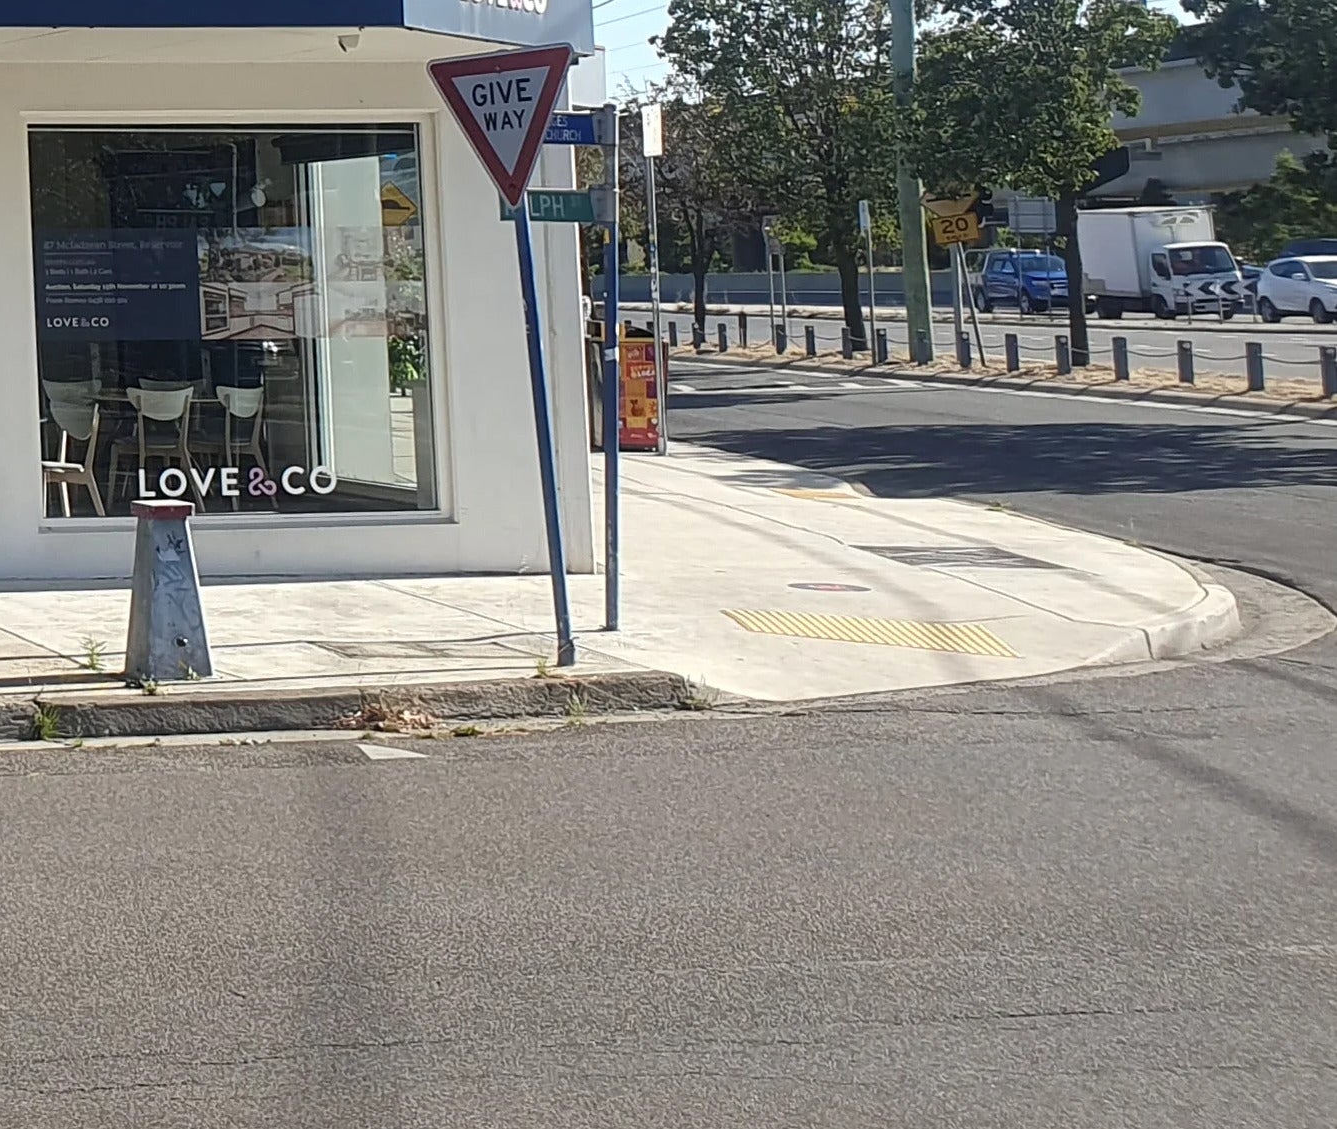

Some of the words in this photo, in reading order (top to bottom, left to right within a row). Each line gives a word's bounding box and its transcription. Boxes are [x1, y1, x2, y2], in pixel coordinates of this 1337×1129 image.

[472, 78, 532, 107] GIVE
[484, 109, 526, 132] WAY
[941, 217, 968, 234] 20
